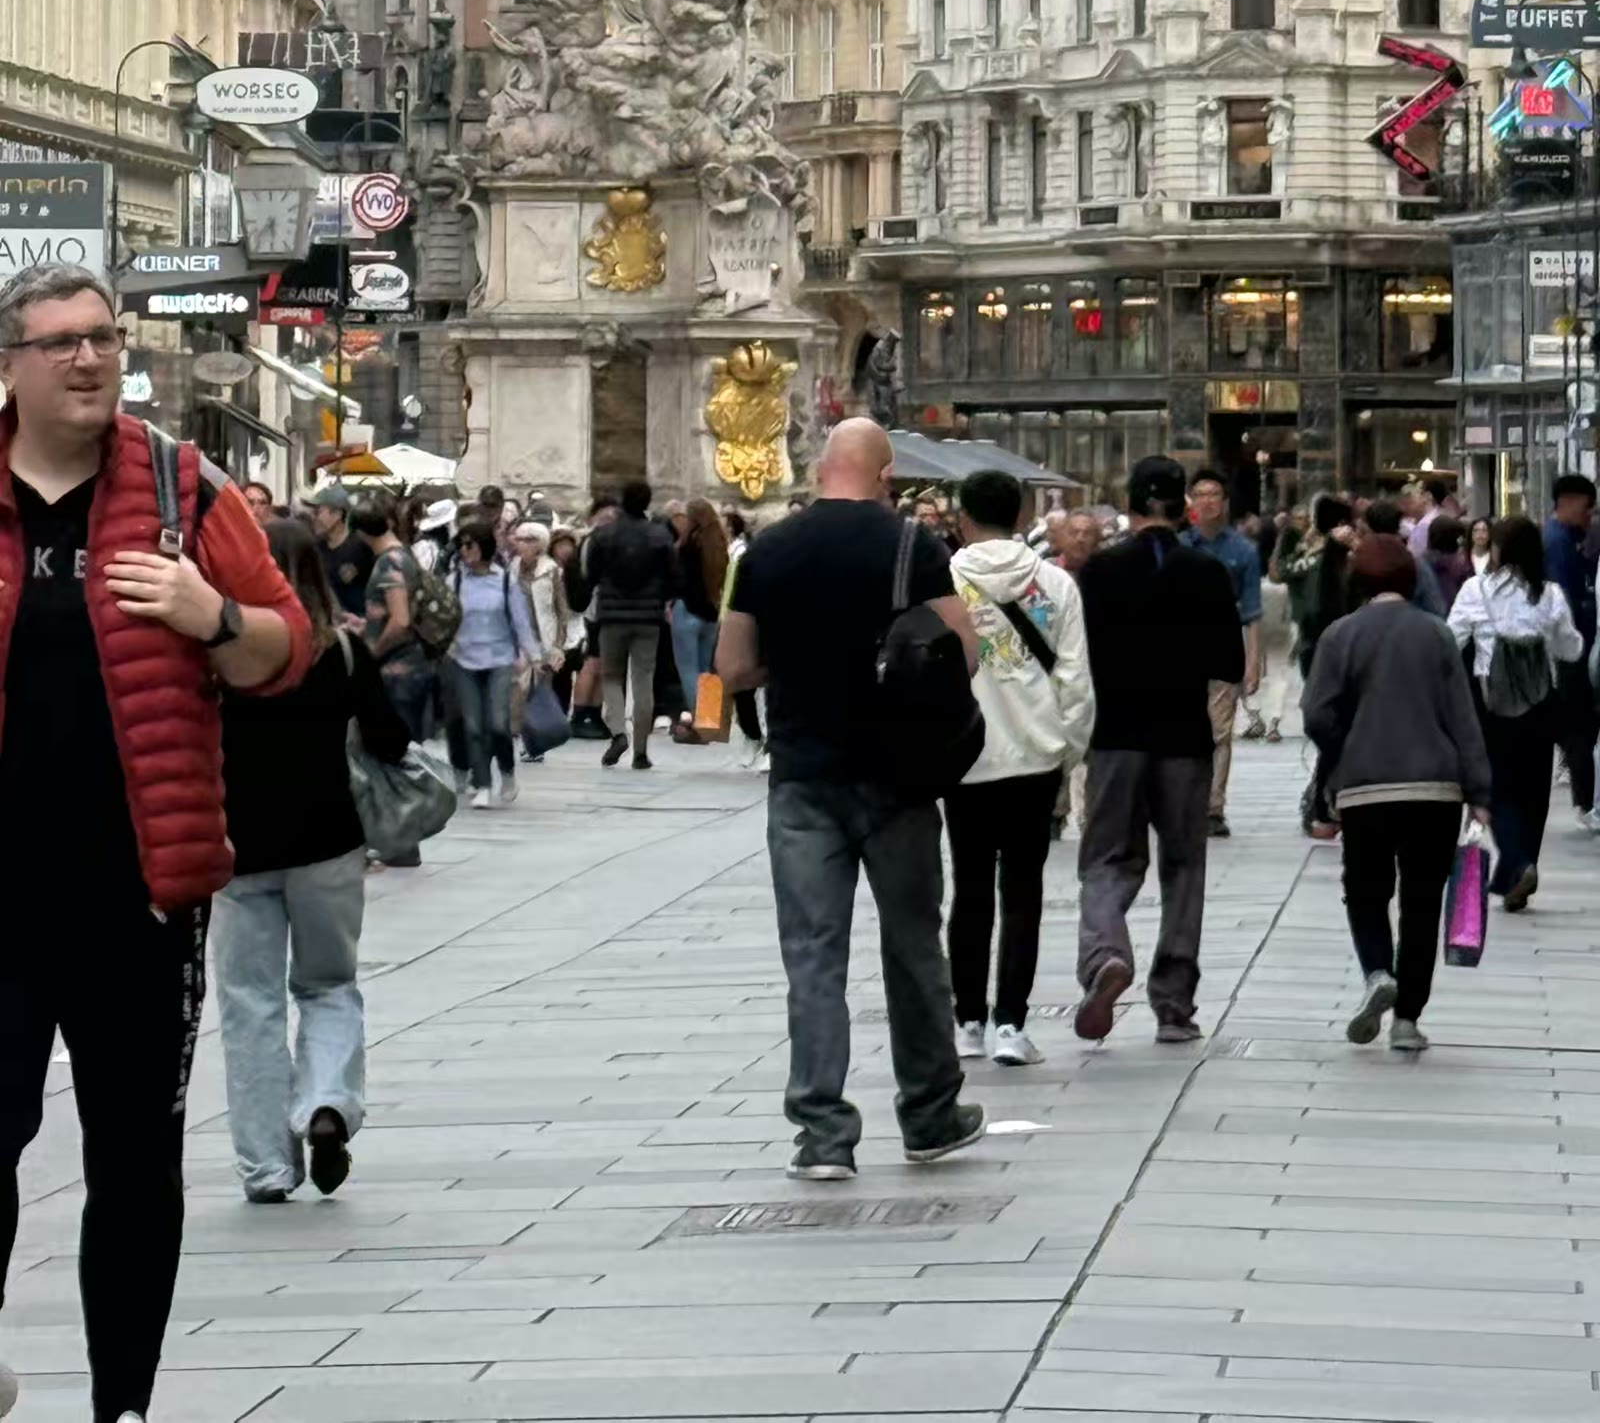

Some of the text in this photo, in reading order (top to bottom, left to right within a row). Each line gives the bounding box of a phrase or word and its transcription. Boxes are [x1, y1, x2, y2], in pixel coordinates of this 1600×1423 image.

[1506, 8, 1588, 28] BUFFET
[213, 82, 299, 99] WORSEG
[148, 292, 234, 314] swatch
